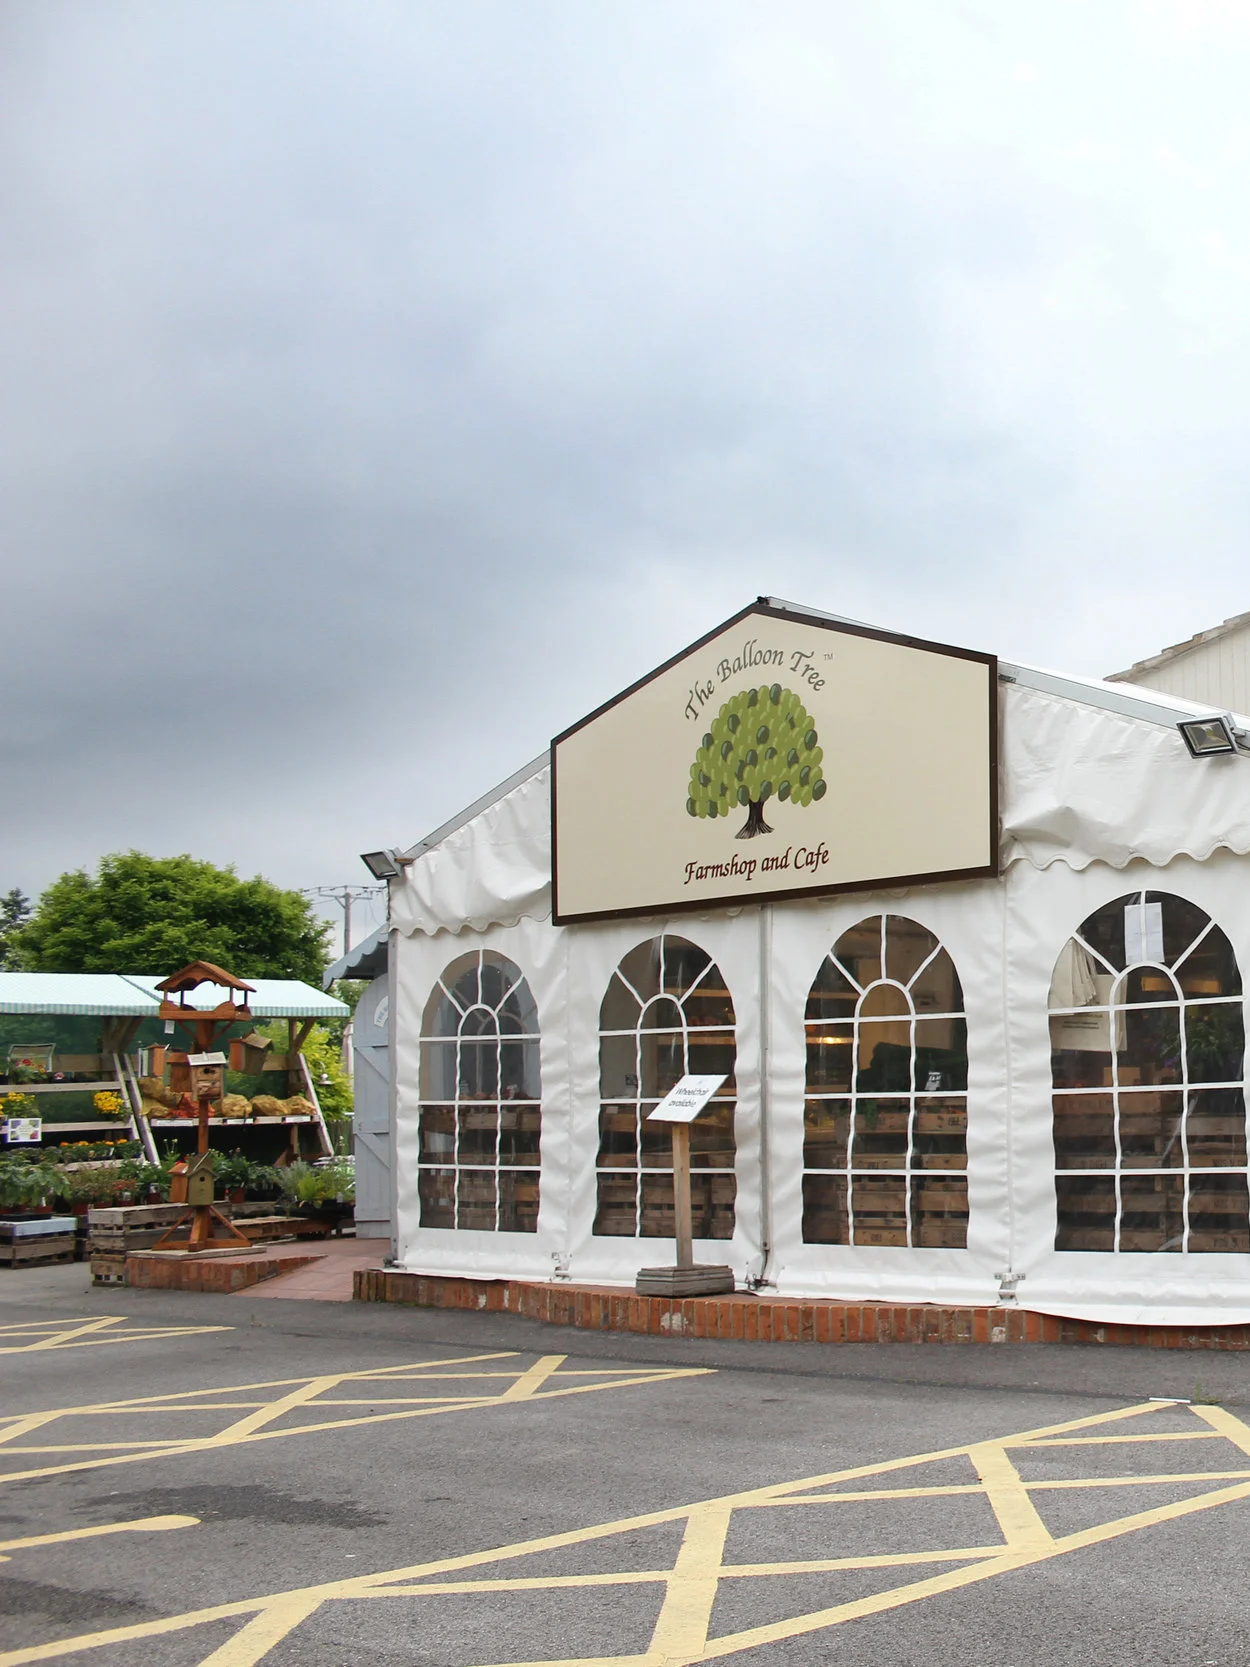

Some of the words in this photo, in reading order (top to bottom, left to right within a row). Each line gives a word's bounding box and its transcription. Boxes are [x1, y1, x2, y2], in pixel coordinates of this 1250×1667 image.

[684, 679, 715, 722] The
[716, 638, 784, 683] Balloon
[790, 650, 826, 692] Tree
[683, 853, 757, 885] Farmshop
[761, 846, 792, 872] and
[794, 841, 830, 874] Cafe
